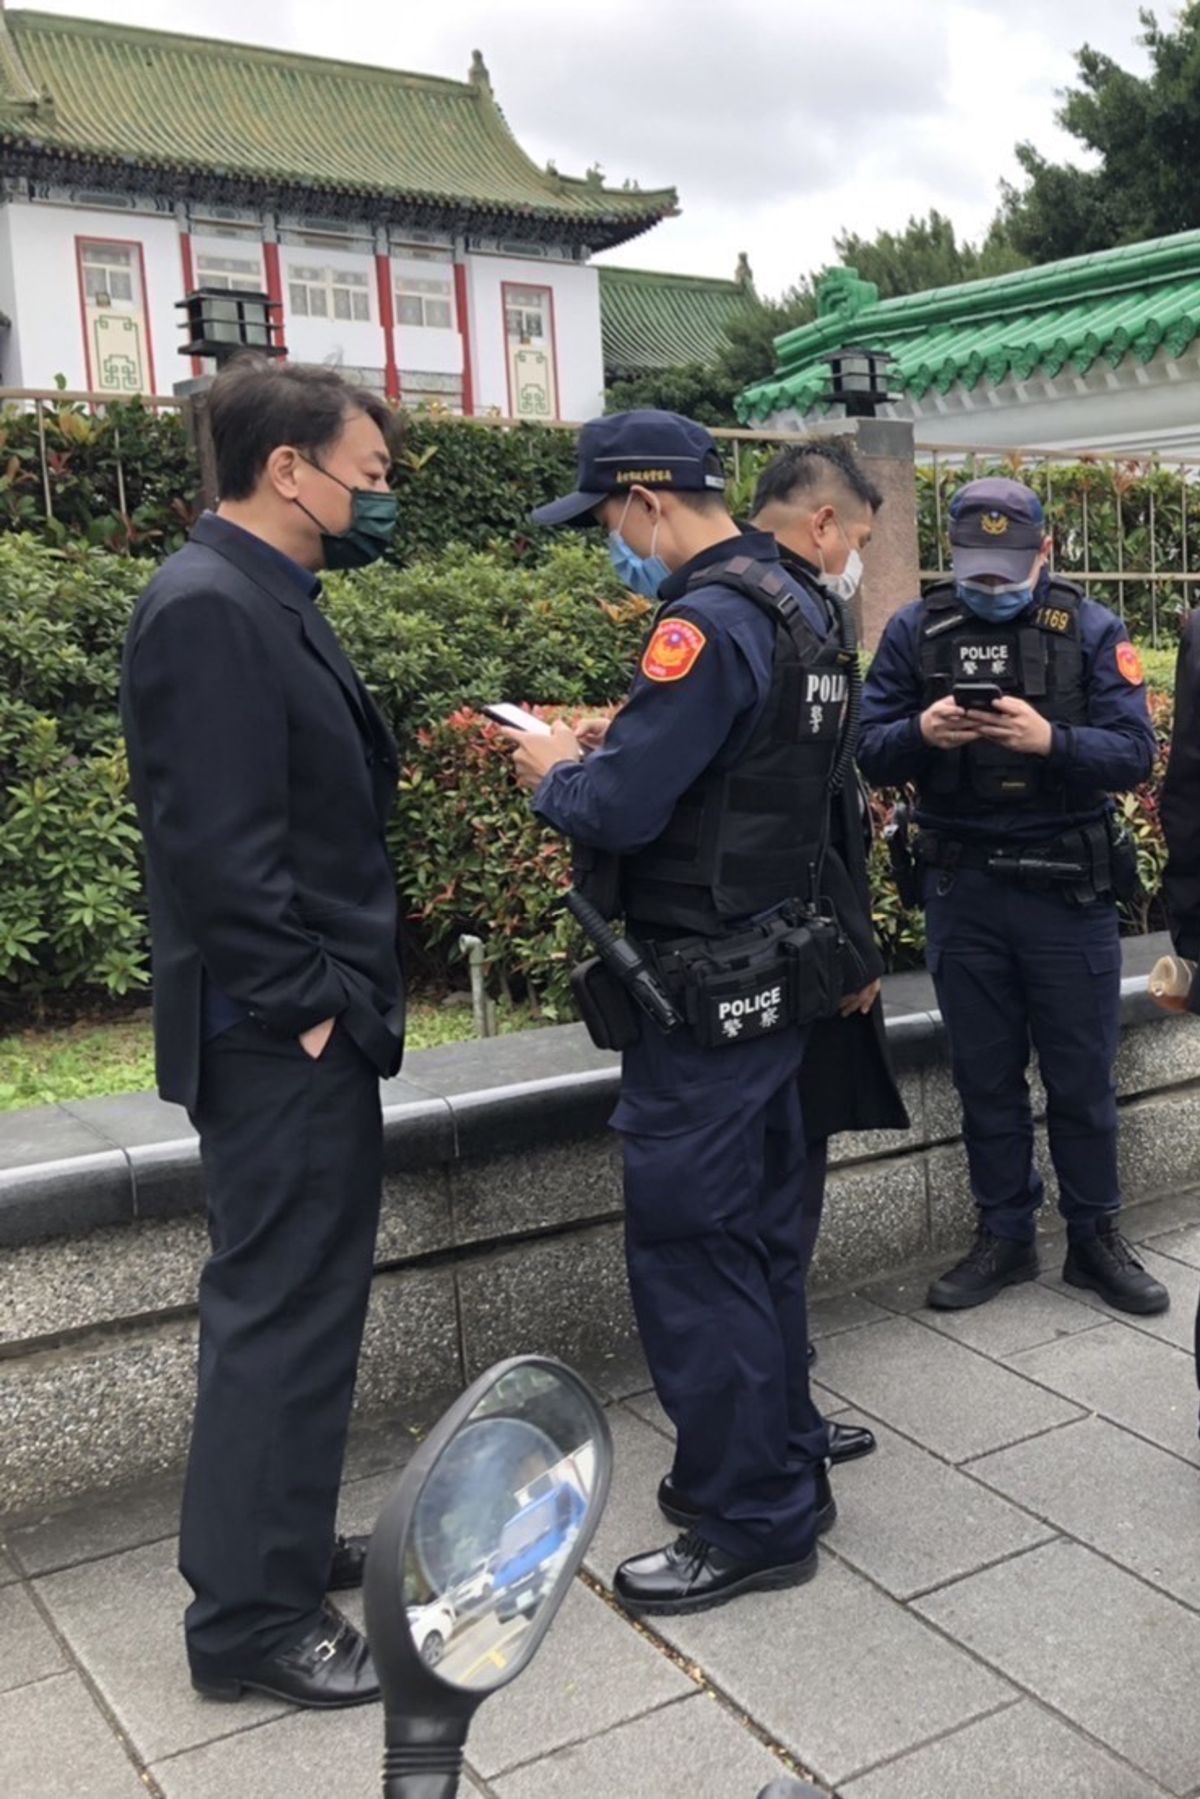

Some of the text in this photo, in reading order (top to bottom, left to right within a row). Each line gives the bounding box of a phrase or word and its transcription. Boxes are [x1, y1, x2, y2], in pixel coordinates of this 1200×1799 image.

[1035, 607, 1069, 630] 1169
[960, 645, 1009, 660] POLICE
[806, 674, 847, 702] POLI
[719, 986, 781, 1020] POLICE
